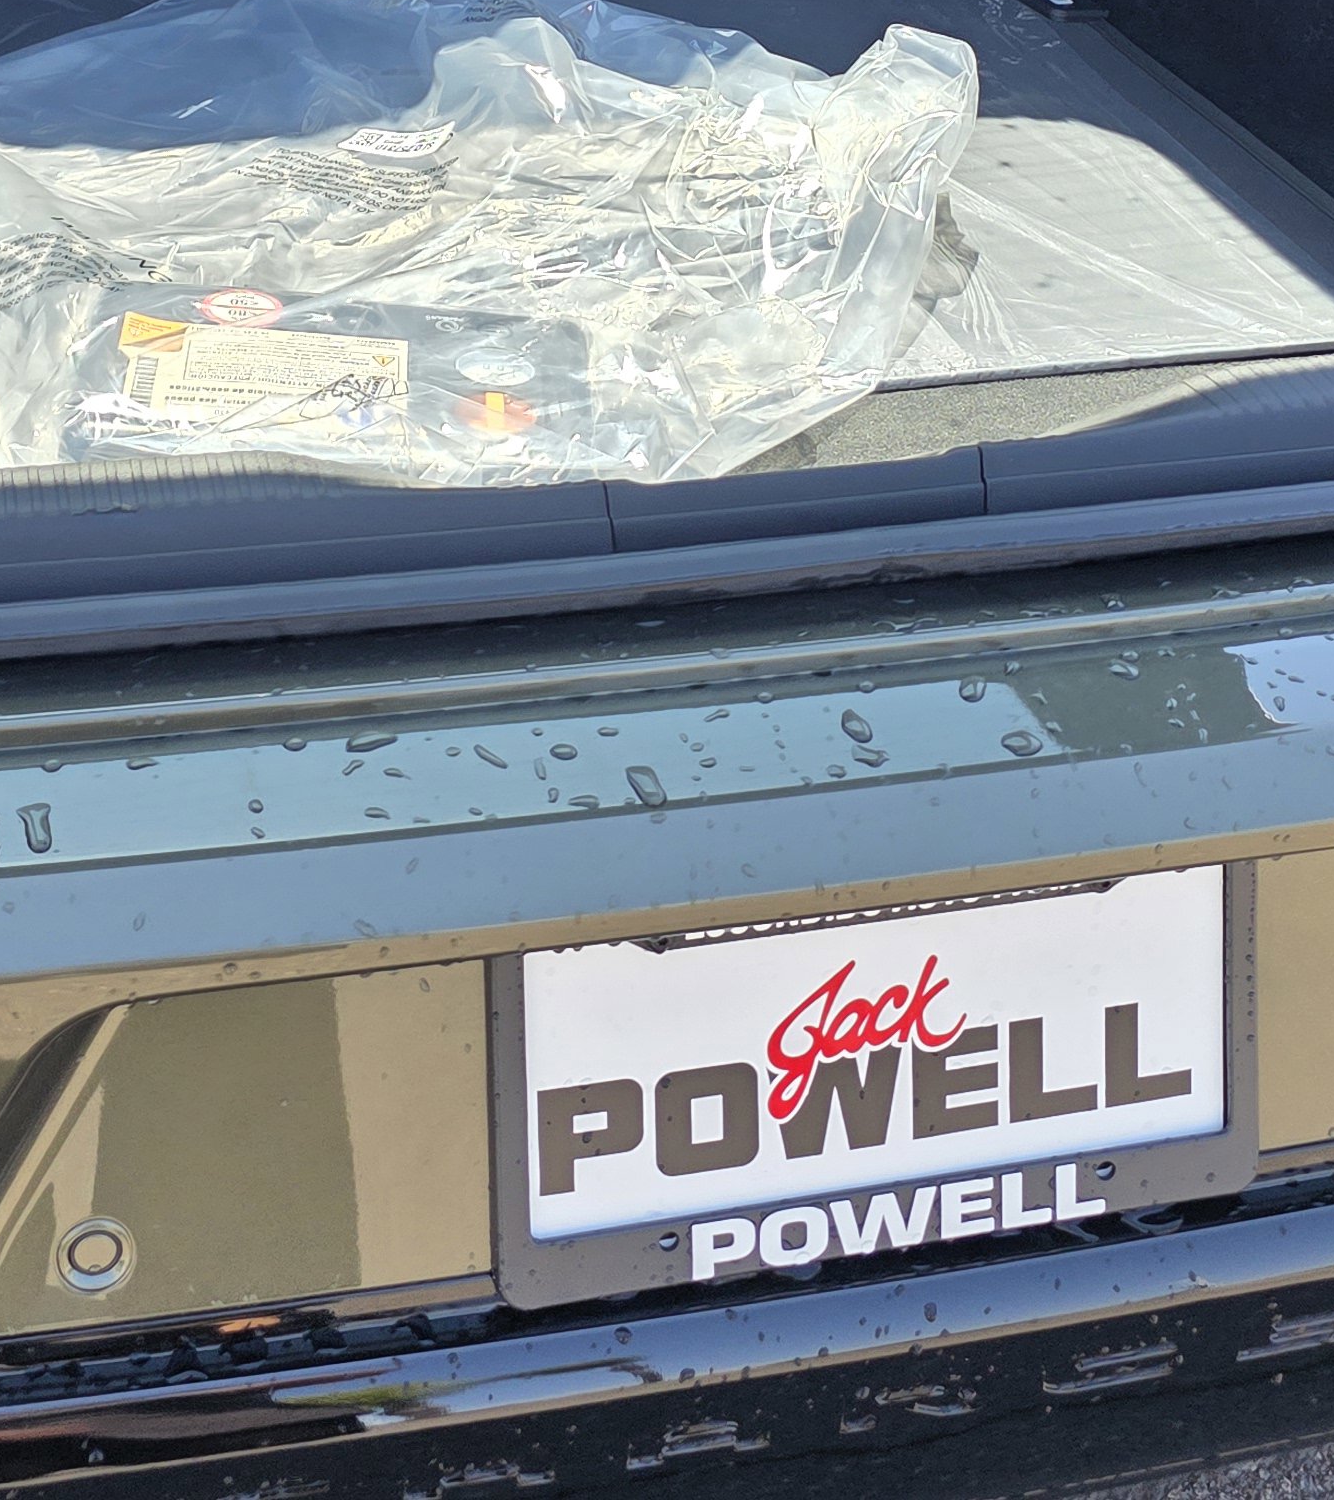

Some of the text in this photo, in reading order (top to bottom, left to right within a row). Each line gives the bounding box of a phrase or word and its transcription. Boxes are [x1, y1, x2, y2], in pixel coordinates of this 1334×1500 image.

[537, 1002, 1193, 1198] POWELL
[767, 954, 967, 1121] Jack
[691, 1162, 1108, 1282] POWELL
